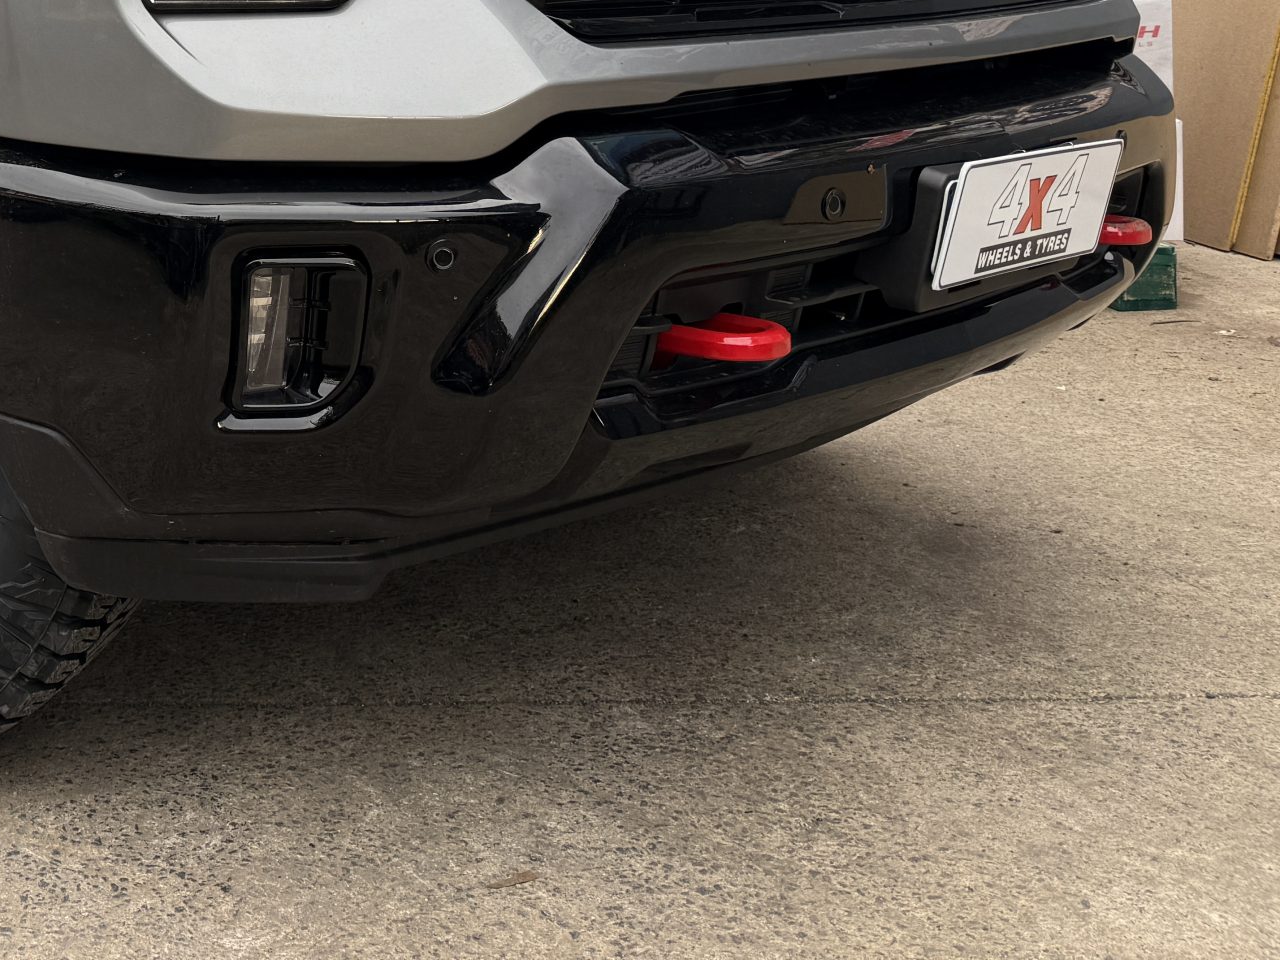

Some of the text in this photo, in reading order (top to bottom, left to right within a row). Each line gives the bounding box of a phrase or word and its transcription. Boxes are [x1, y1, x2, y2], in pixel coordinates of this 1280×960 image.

[977, 232, 1069, 269] WHEELS & TYRES
